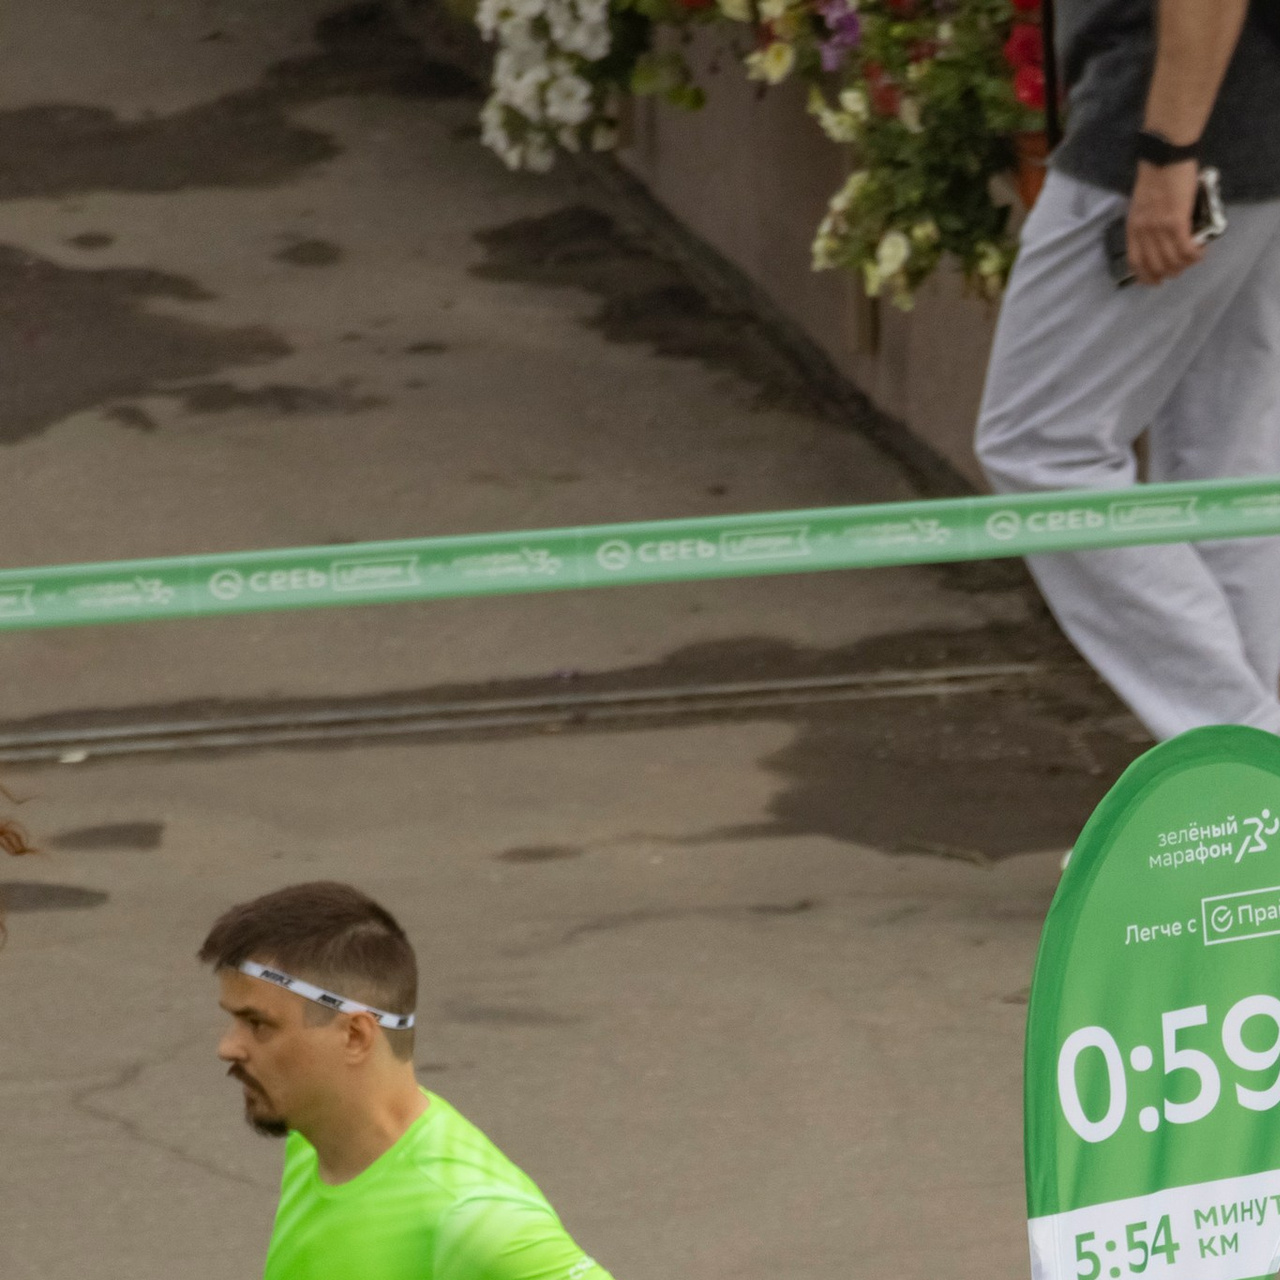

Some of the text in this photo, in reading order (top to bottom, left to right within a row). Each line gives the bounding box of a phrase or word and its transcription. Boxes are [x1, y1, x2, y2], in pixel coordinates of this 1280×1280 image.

[1157, 815, 1239, 847] зелёный
[1149, 841, 1233, 869] марафон
[1125, 921, 1183, 945] Легче
[1187, 918, 1197, 933] с
[1198, 1232, 1239, 1259] км
